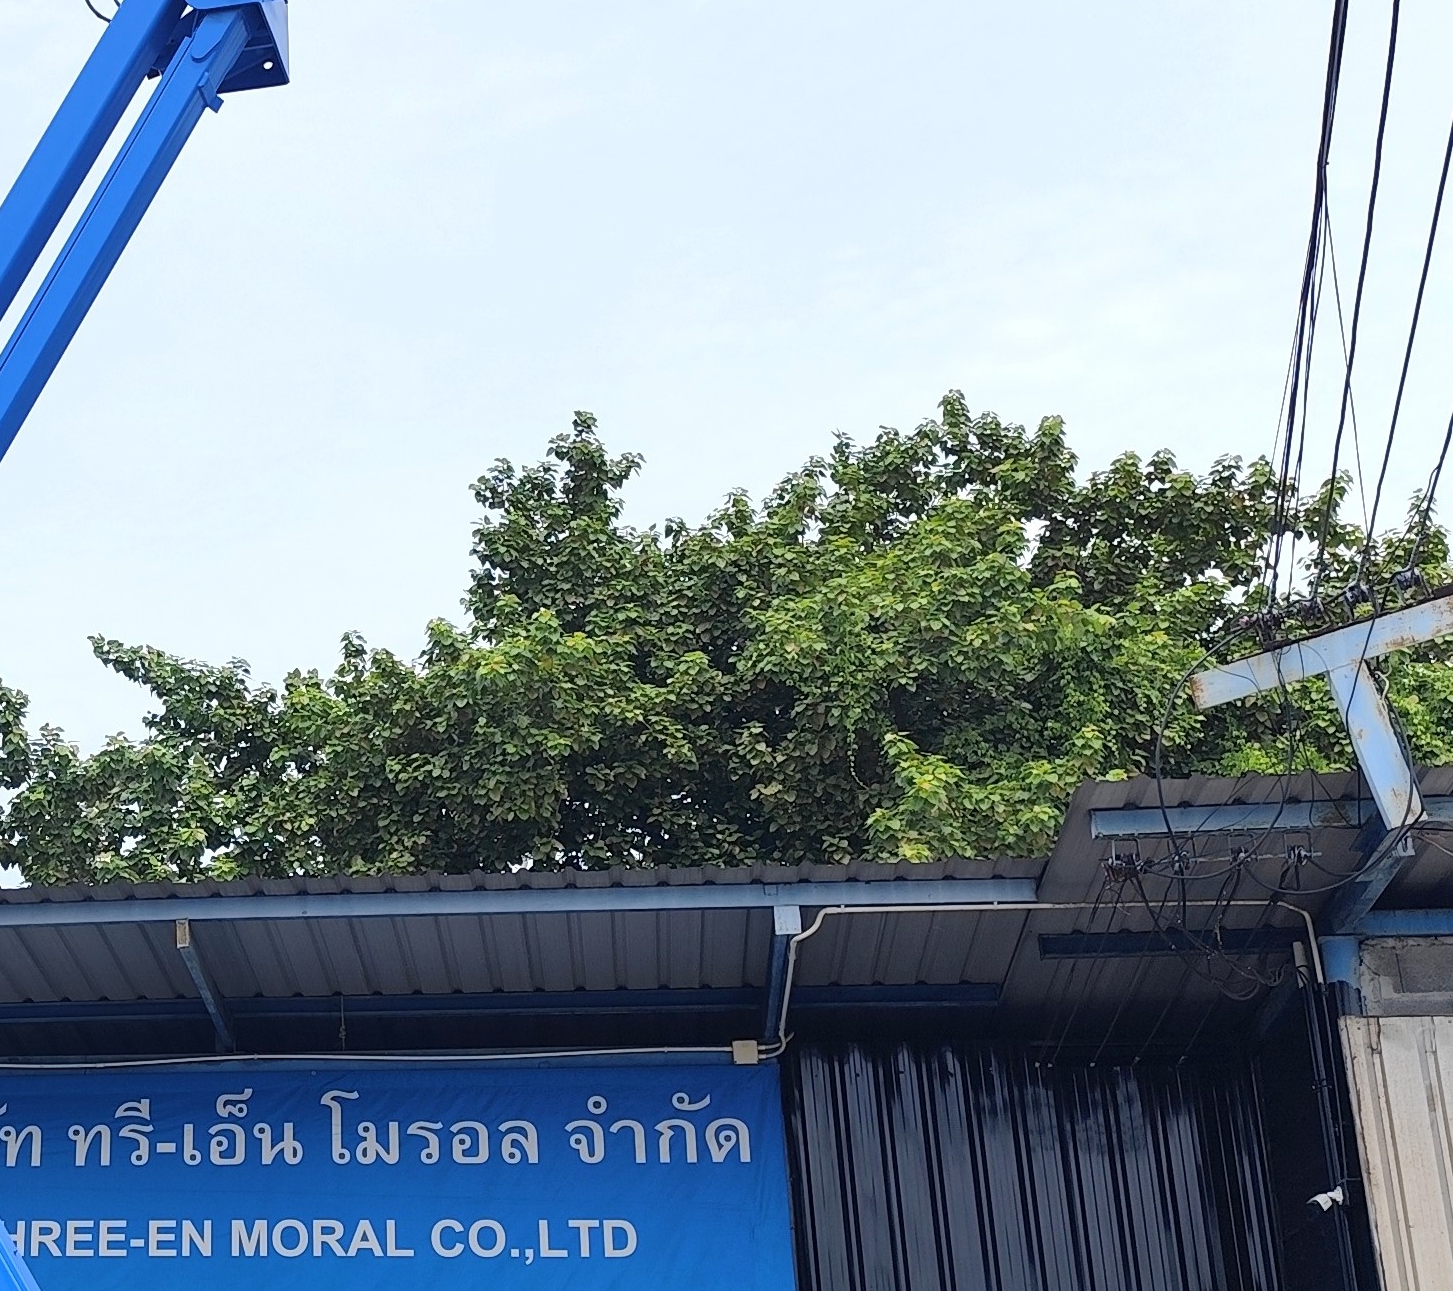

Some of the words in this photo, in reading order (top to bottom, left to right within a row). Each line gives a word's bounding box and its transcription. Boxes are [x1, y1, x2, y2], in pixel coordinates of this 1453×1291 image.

[68, 1088, 303, 1167] ทรี-เอ็น
[321, 1089, 539, 1165] โมรอล
[564, 1092, 752, 1164] จำกัด
[4, 1219, 213, 1257] HREE-EN
[230, 1218, 415, 1258] MORAL
[430, 1218, 638, 1265] CO.,LTD
